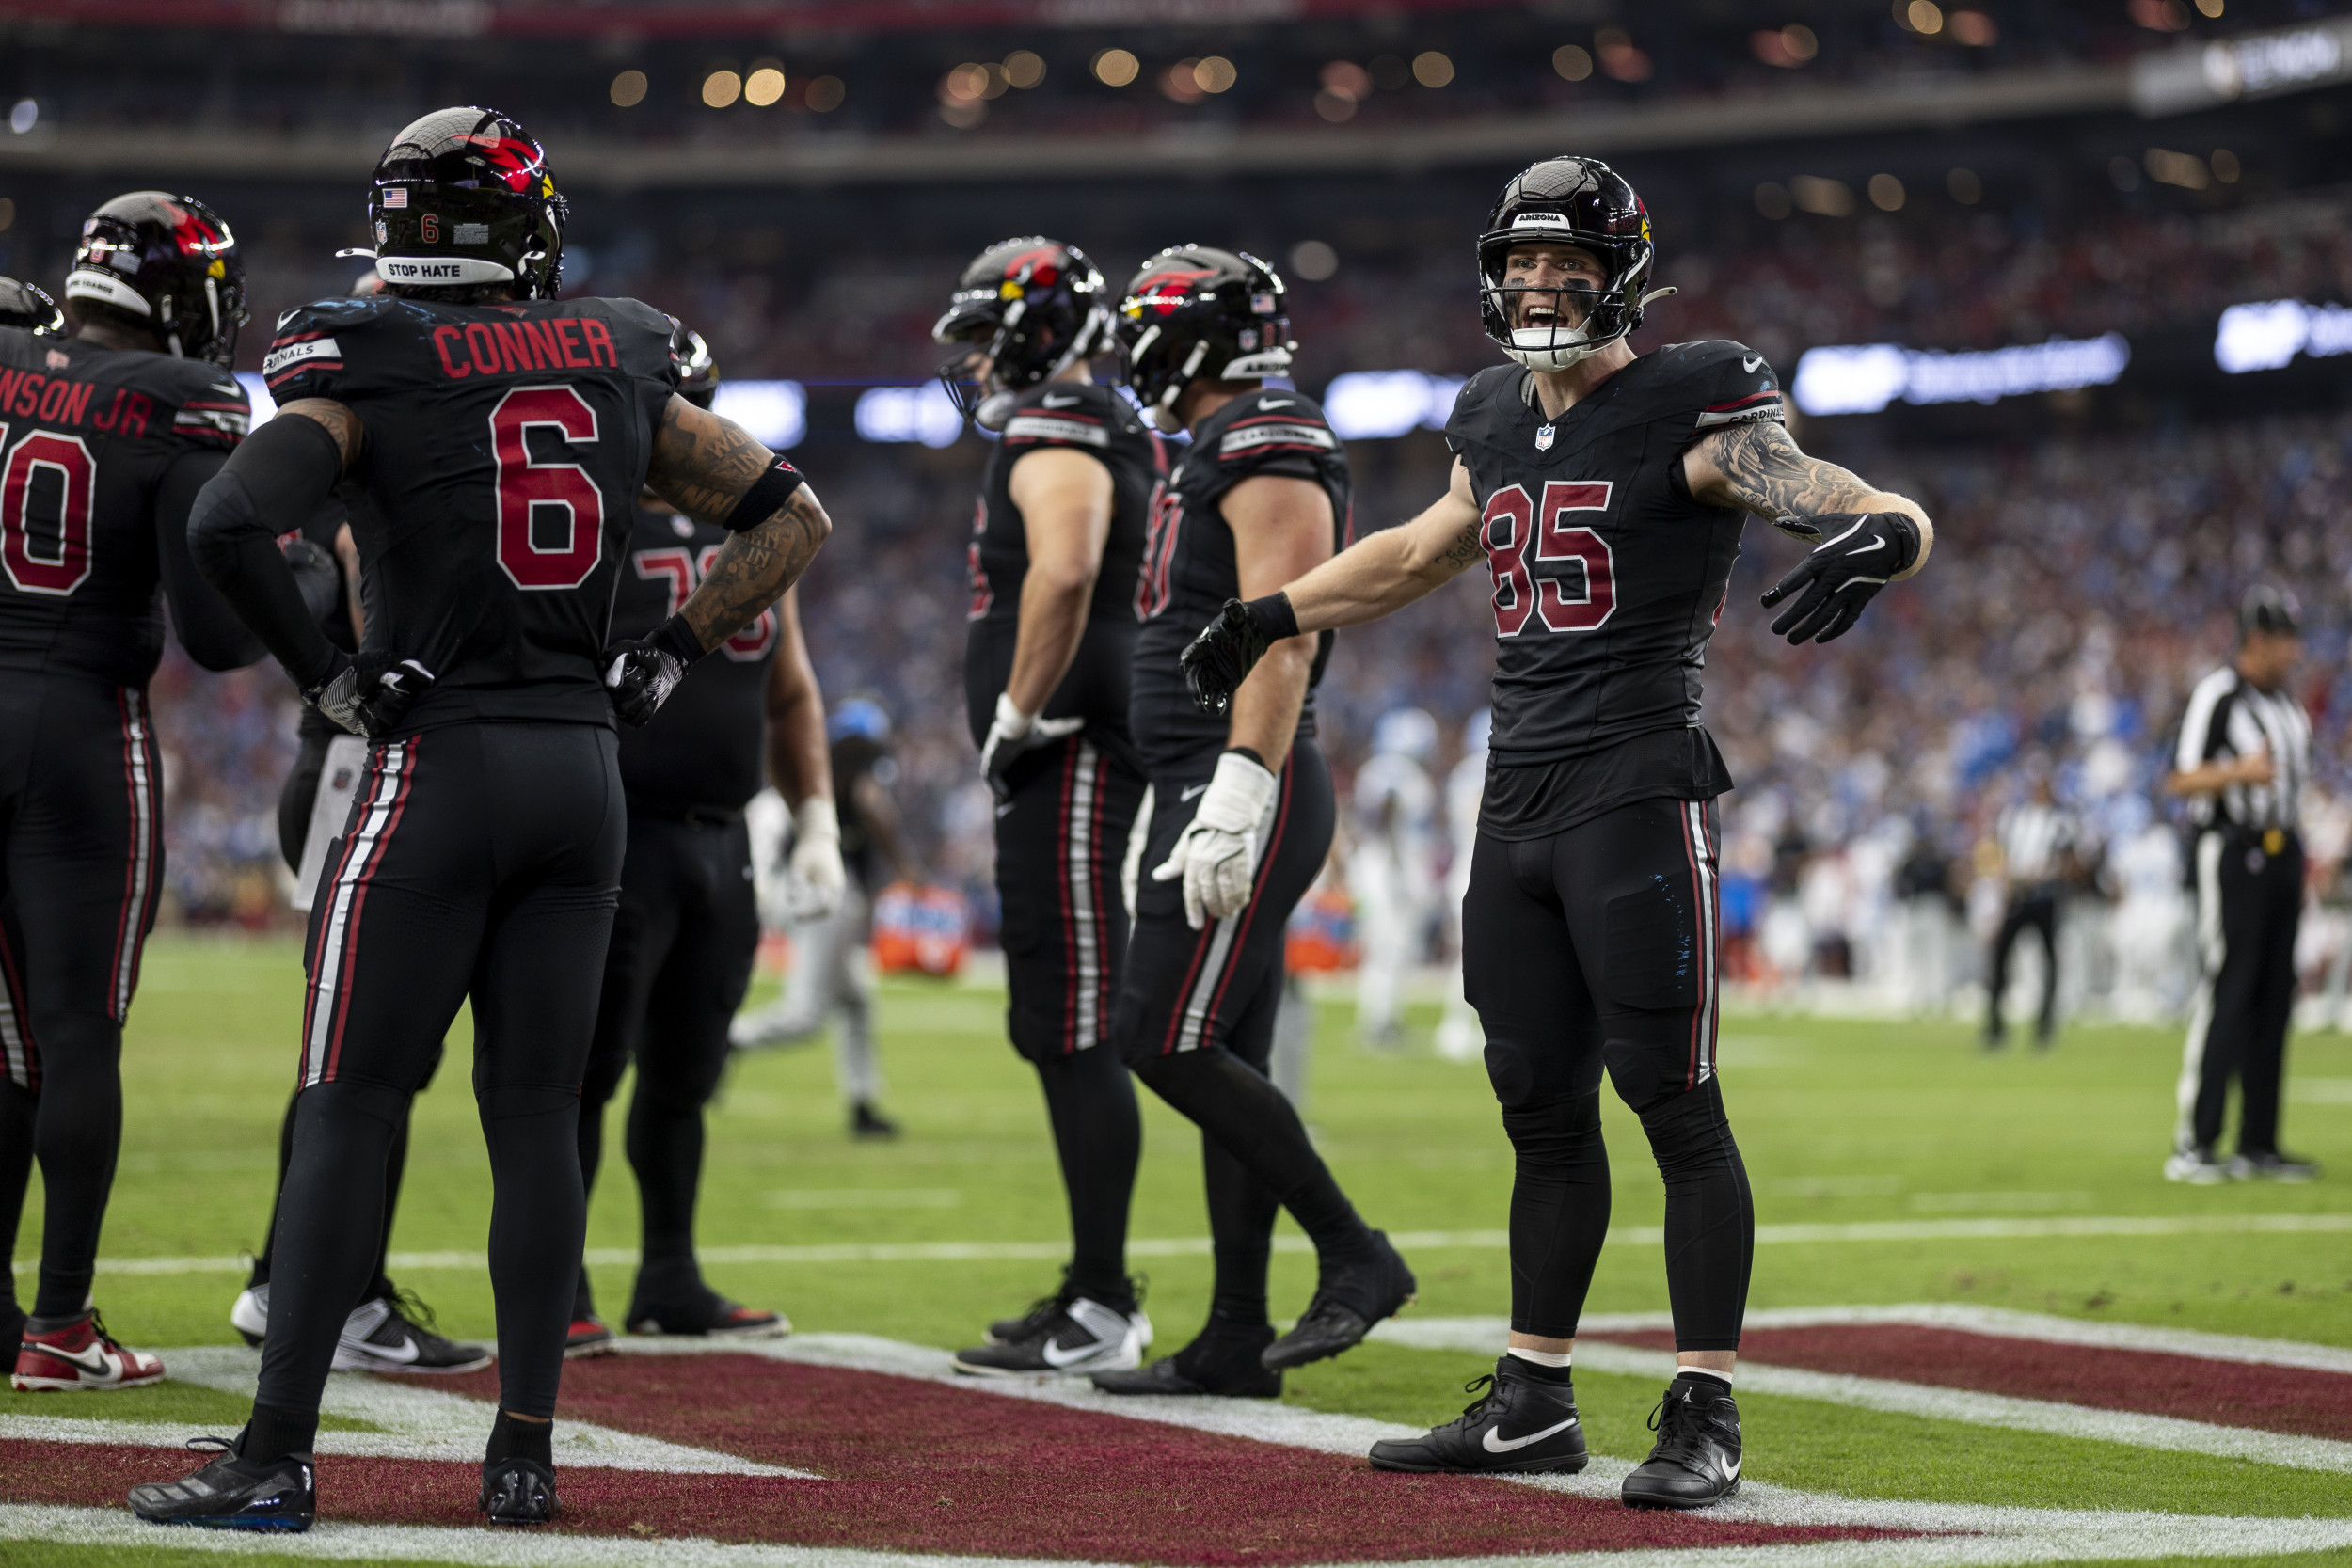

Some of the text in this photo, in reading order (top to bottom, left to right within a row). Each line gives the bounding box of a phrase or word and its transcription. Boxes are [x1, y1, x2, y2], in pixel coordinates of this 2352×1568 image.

[421, 214, 439, 244] 6
[388, 263, 461, 277] STOP HATE
[432, 317, 619, 379] CONNER
[0, 365, 153, 438] NSON JR
[0, 420, 97, 597] 0
[487, 384, 606, 591] 6
[1480, 480, 1618, 639] 85
